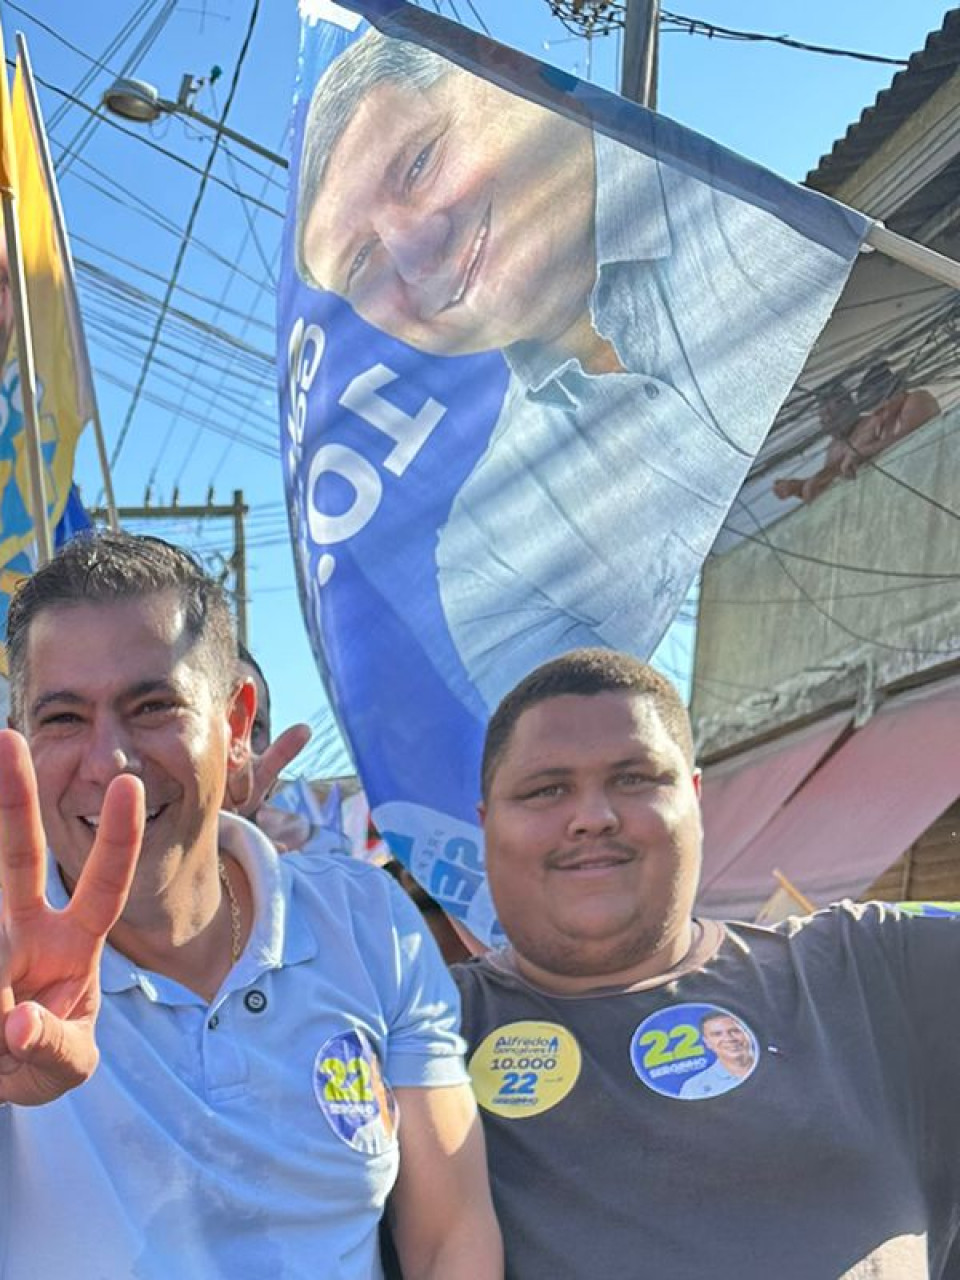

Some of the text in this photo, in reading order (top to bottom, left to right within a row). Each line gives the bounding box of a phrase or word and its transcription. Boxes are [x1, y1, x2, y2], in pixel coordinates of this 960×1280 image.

[640, 1025, 705, 1069] 22
[490, 1058, 556, 1071] 10.000
[498, 1072, 538, 1095] 22
